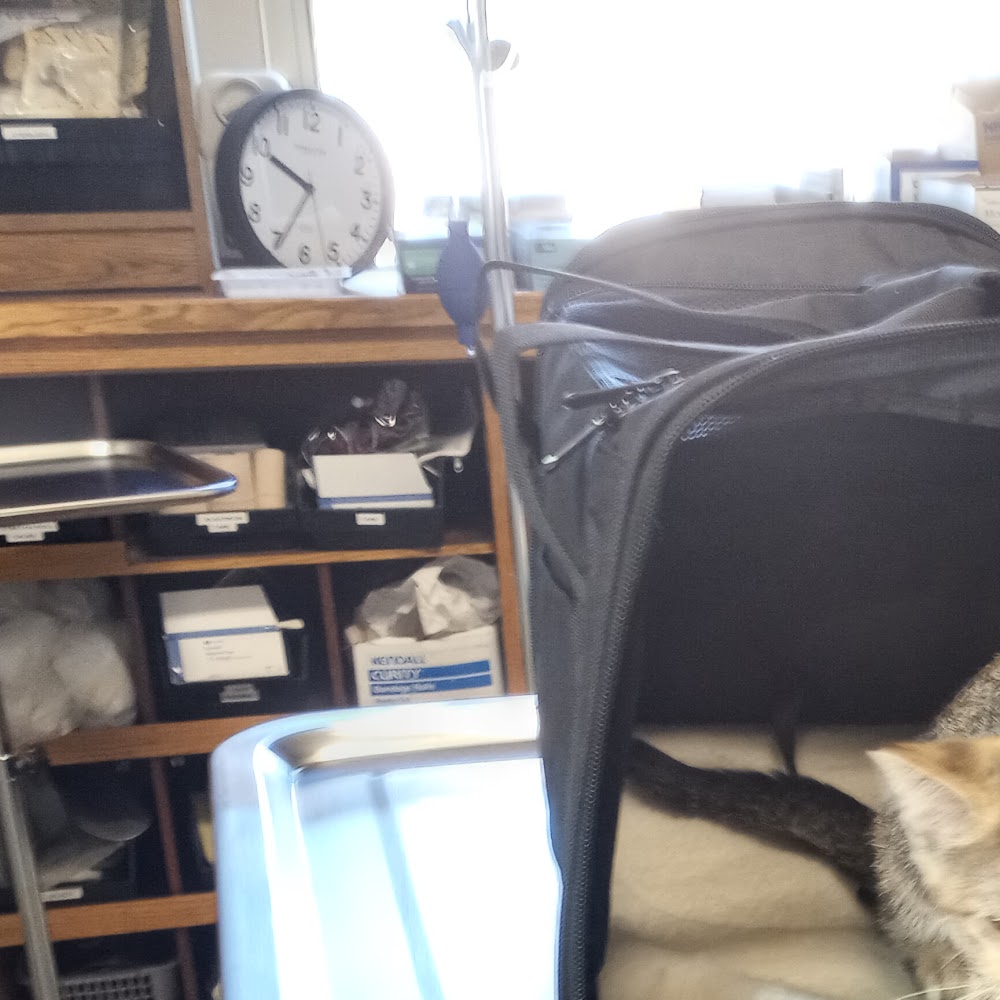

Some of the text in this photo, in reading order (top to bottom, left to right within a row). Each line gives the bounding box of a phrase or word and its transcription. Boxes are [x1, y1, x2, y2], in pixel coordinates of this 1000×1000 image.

[276, 111, 290, 137] 11
[302, 109, 321, 133] 12
[252, 136, 272, 158] 10
[337, 127, 344, 147] 1
[354, 155, 366, 175] 2
[240, 166, 254, 188] 9
[360, 190, 373, 210] 3
[247, 203, 262, 223] 8
[350, 224, 369, 242] 4
[299, 245, 311, 266] 6
[326, 241, 341, 262] 5
[370, 668, 421, 681] CURITY
